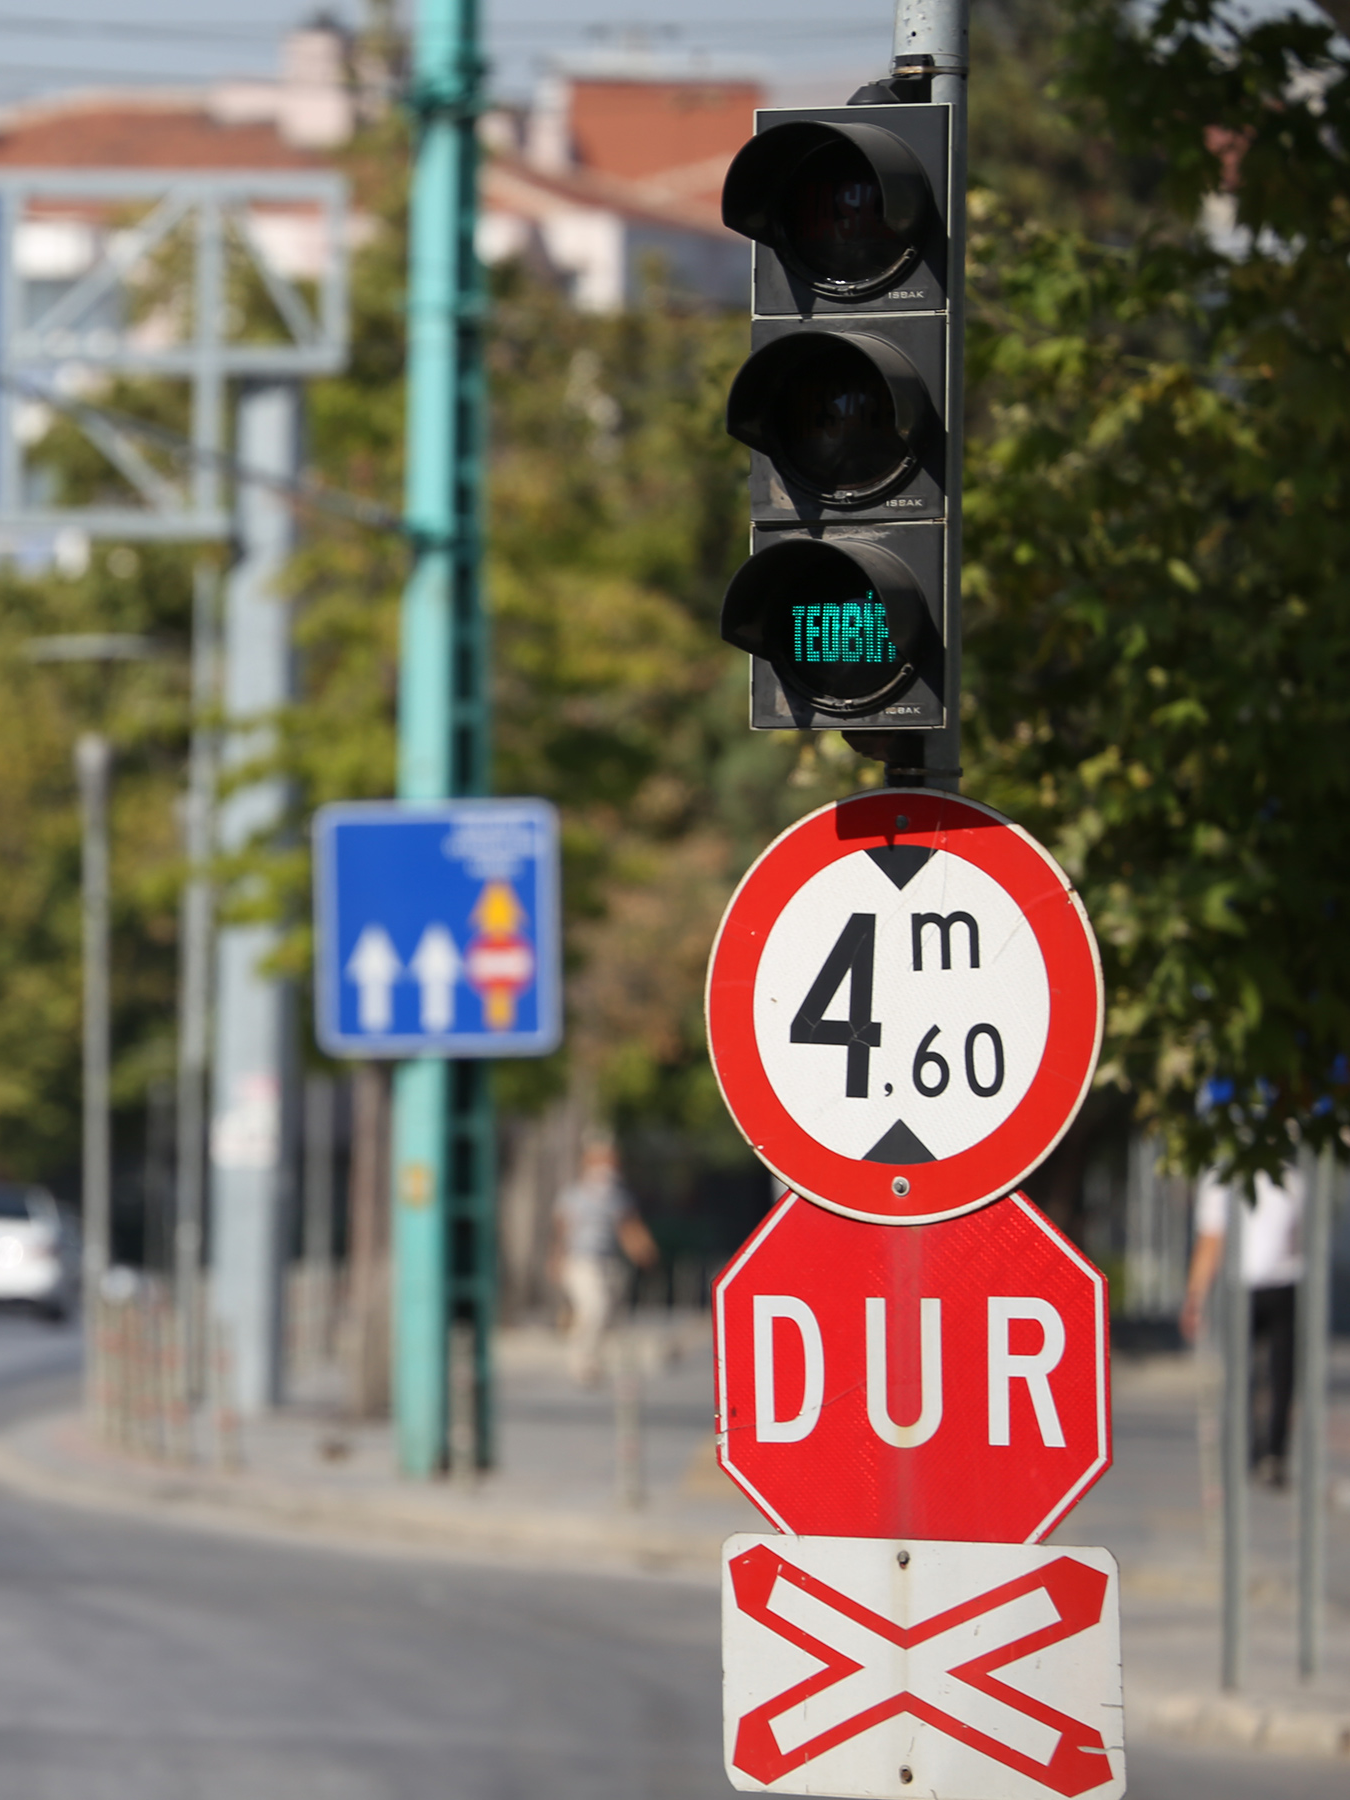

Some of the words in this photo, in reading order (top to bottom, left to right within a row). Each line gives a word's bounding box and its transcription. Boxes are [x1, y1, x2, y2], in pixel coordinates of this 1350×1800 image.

[888, 291, 924, 299] ISBAK
[885, 499, 923, 507] ISBAK
[911, 911, 980, 972] m
[752, 1294, 1067, 1449] DUR
